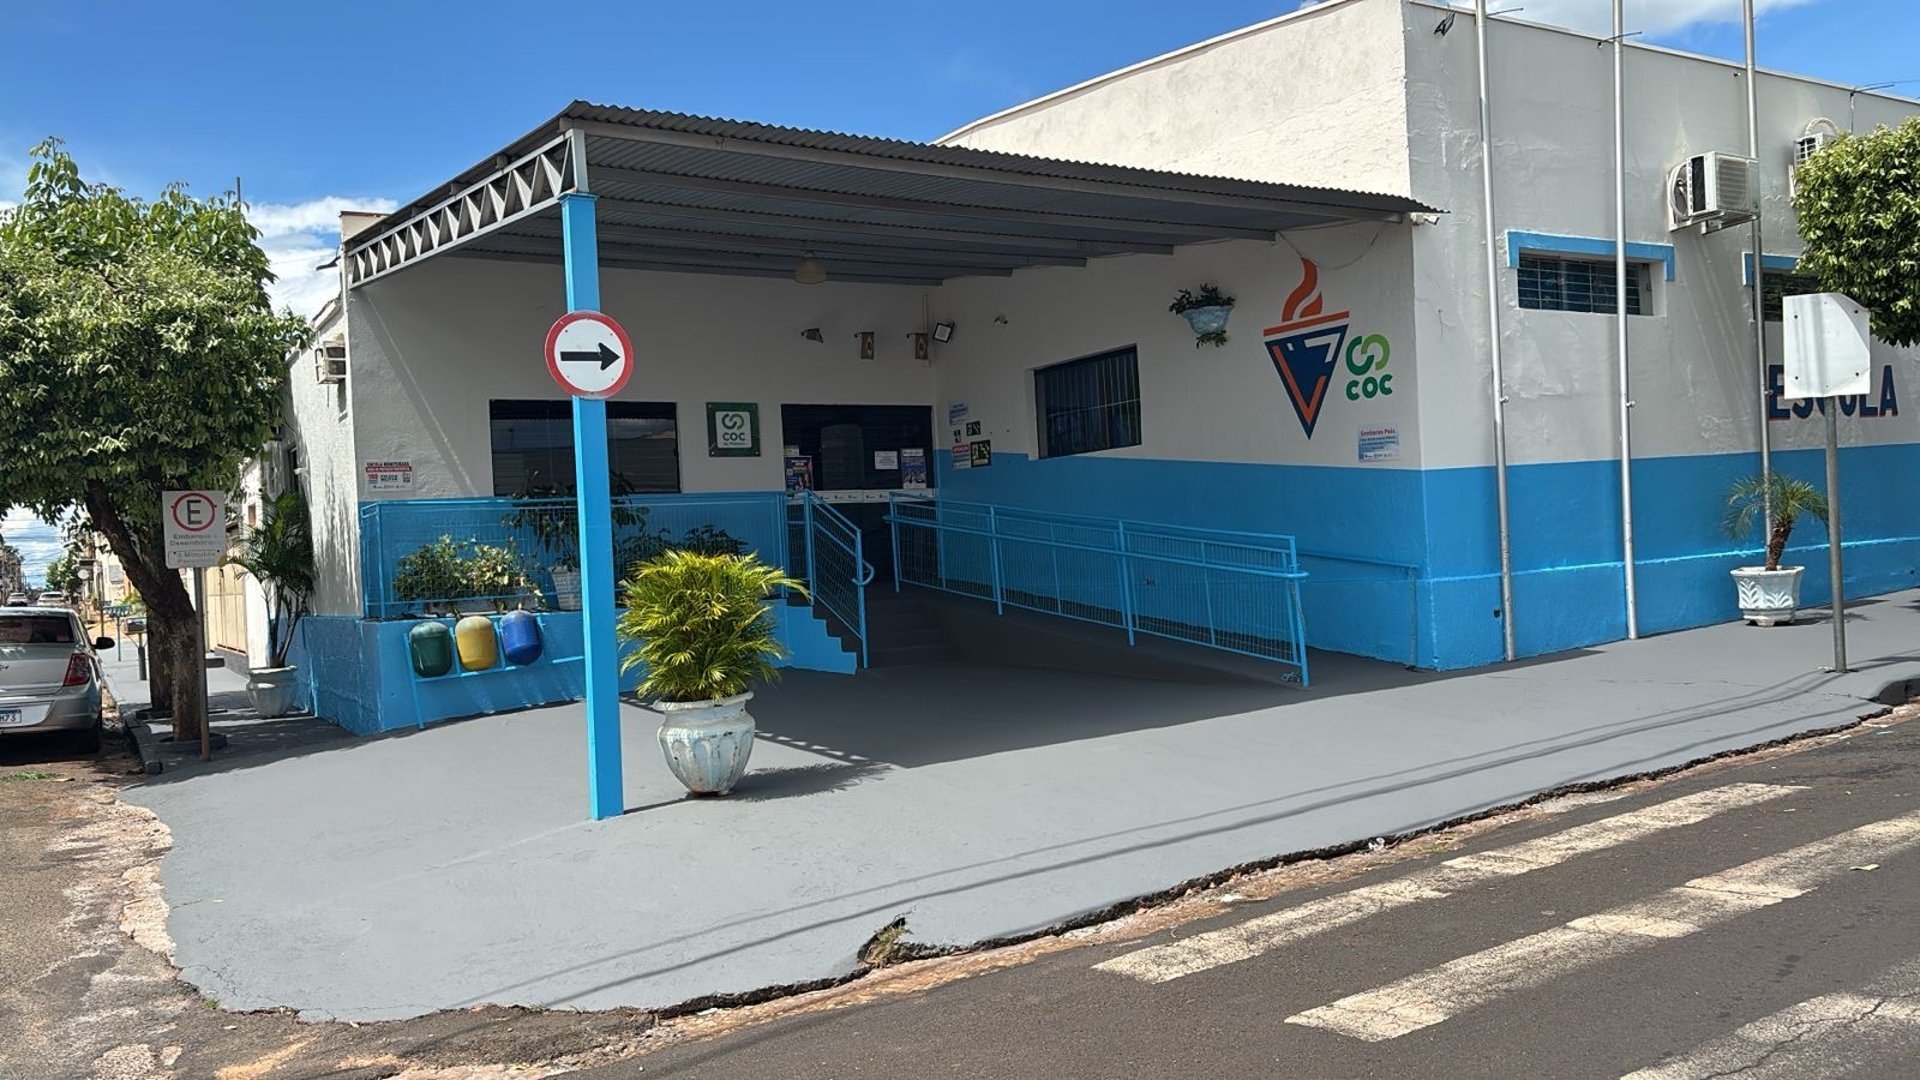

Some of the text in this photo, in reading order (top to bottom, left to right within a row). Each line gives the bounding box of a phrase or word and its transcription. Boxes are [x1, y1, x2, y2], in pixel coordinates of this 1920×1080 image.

[1345, 374, 1393, 401] COC
[1768, 364, 1899, 420] ELA
[722, 432, 746, 442] COC
[186, 499, 202, 525] E
